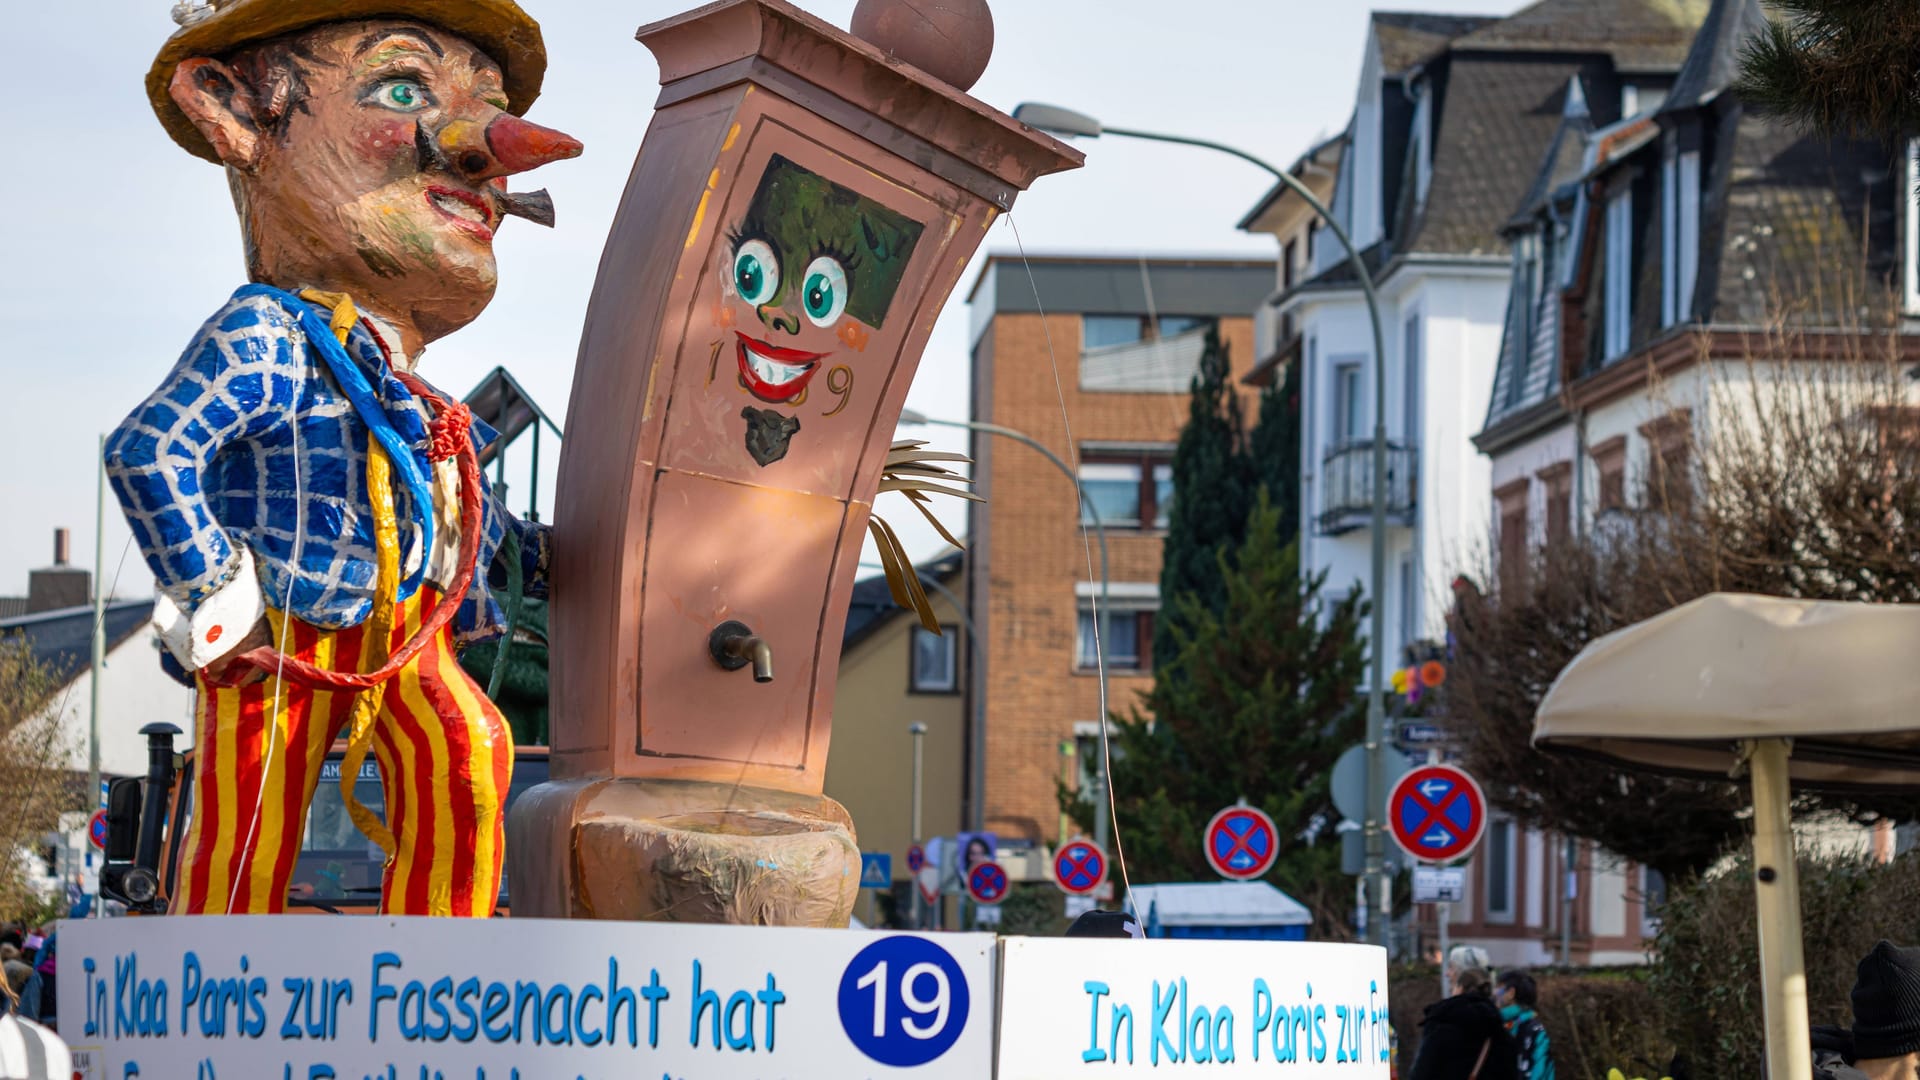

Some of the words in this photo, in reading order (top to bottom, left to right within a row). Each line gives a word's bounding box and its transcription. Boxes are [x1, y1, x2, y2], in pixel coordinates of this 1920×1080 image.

[83, 957, 106, 1038] In
[114, 951, 168, 1038] Klaa
[181, 951, 266, 1038] Paris
[280, 977, 353, 1040] zur
[368, 952, 668, 1047] Fassenacht
[689, 959, 785, 1052] hat
[856, 960, 950, 1039] 19
[1082, 981, 1134, 1064] In
[1150, 976, 1235, 1066] Klaa
[1252, 977, 1326, 1064] Paris
[1335, 1004, 1366, 1064] zur
